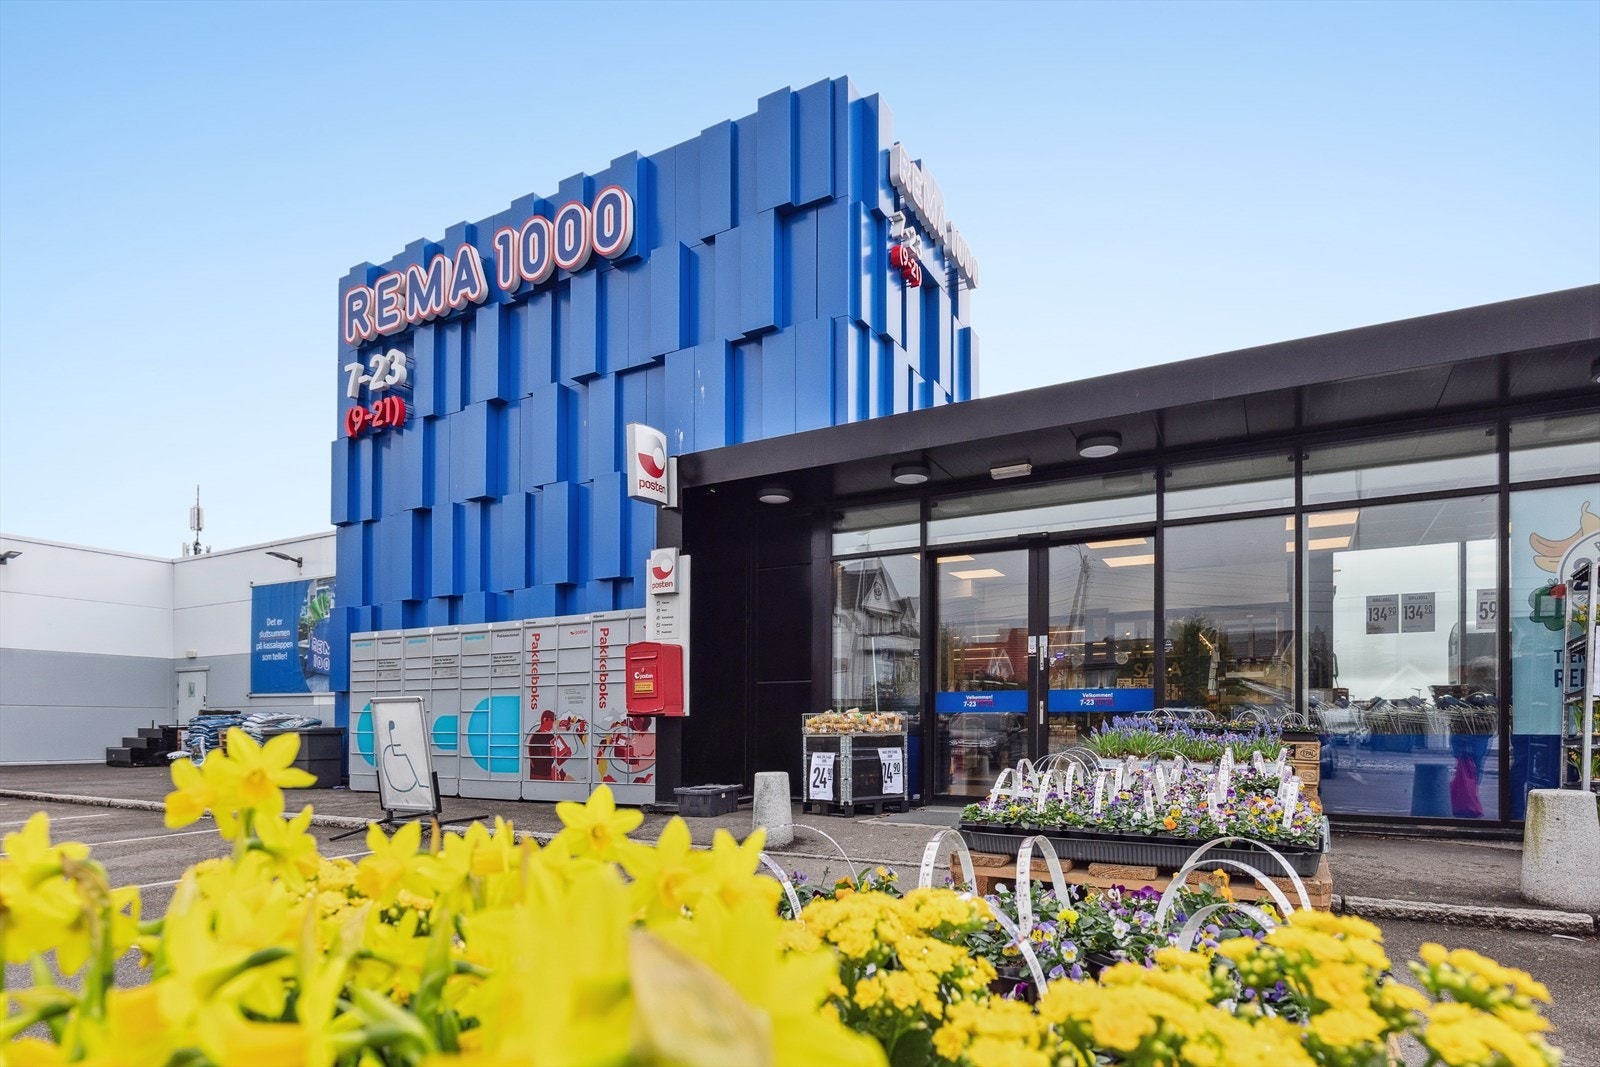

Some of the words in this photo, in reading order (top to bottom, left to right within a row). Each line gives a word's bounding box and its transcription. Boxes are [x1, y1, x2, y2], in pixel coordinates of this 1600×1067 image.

[890, 143, 948, 245] REMA
[944, 220, 979, 291] 1000
[343, 243, 488, 348] REMA
[493, 185, 633, 294] 1000
[344, 348, 407, 400] 7-23
[344, 395, 406, 439] (9-21)
[638, 477, 666, 494] posten
[652, 580, 674, 589] posten
[1368, 606, 1388, 622] 134
[1388, 606, 1397, 614] 90
[1403, 604, 1424, 620] 134
[1424, 604, 1433, 613] 90
[1479, 601, 1497, 620] 59
[266, 617, 276, 626] Det
[259, 630, 291, 638] sluttsummen
[256, 641, 263, 651] på
[263, 641, 294, 650] kassalappen
[1553, 649, 1586, 664] TEN
[531, 633, 541, 710] Pakkeboks
[599, 627, 609, 709] Pakkeboks
[893, 762, 901, 773] 90
[812, 766, 827, 789] 24
